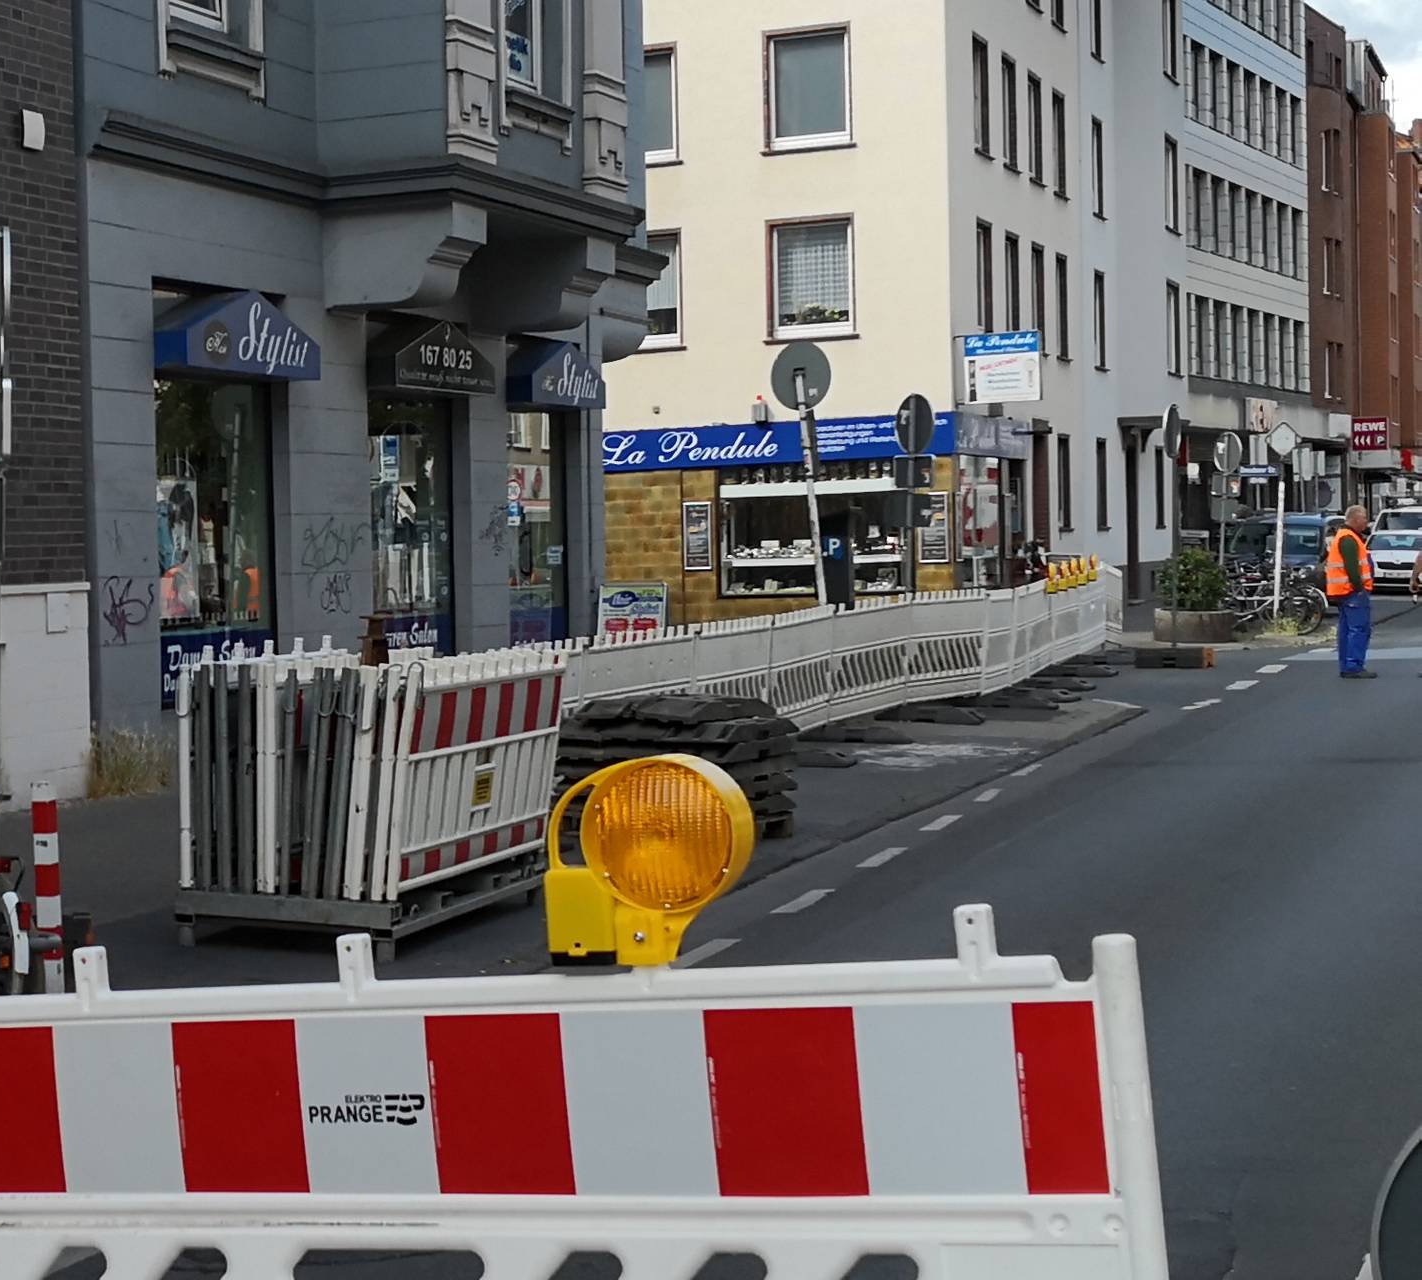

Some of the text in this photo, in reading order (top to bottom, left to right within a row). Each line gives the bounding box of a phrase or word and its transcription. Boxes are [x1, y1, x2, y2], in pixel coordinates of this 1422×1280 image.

[239, 302, 308, 375] Stylist
[419, 344, 473, 370] 167 80 25
[558, 352, 599, 405] Stylist
[1354, 421, 1386, 431] REWE
[602, 431, 778, 466] La Pendule
[409, 621, 439, 645] Salon
[344, 1094, 382, 1103] ELEKTRO
[308, 1105, 384, 1123] PRANGE
